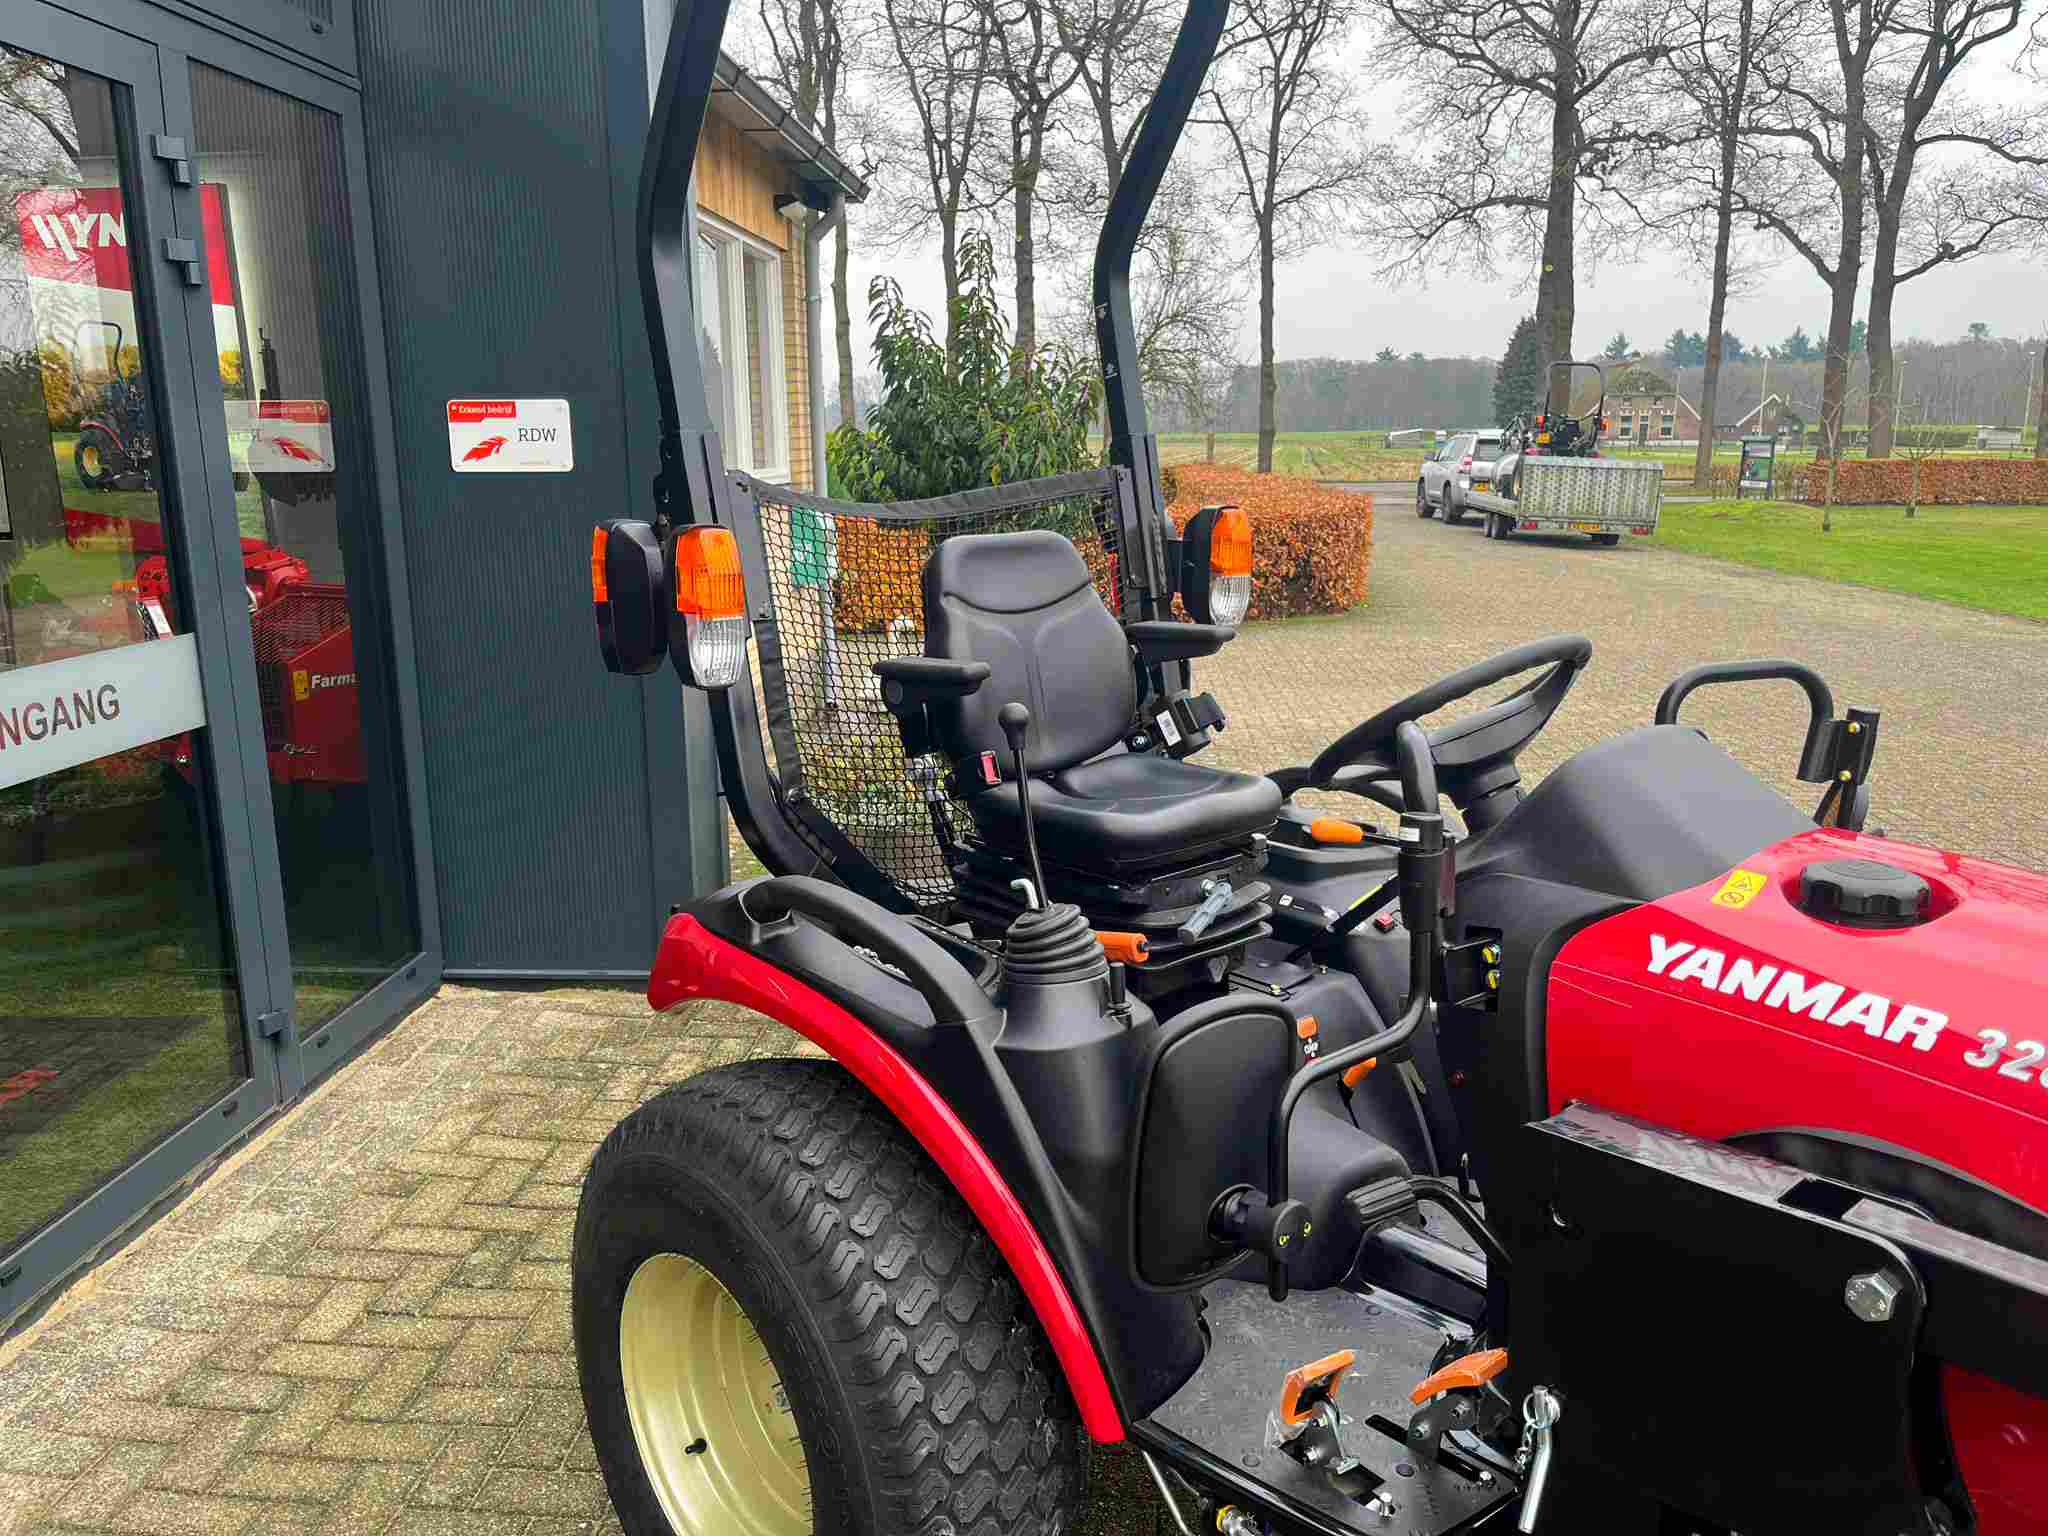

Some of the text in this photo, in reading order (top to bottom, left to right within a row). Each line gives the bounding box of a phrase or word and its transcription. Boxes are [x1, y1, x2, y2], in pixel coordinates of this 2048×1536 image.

[518, 427, 557, 442] RDW
[0, 683, 121, 751] NGANG
[1647, 933, 2048, 1088] YANMAR 32
